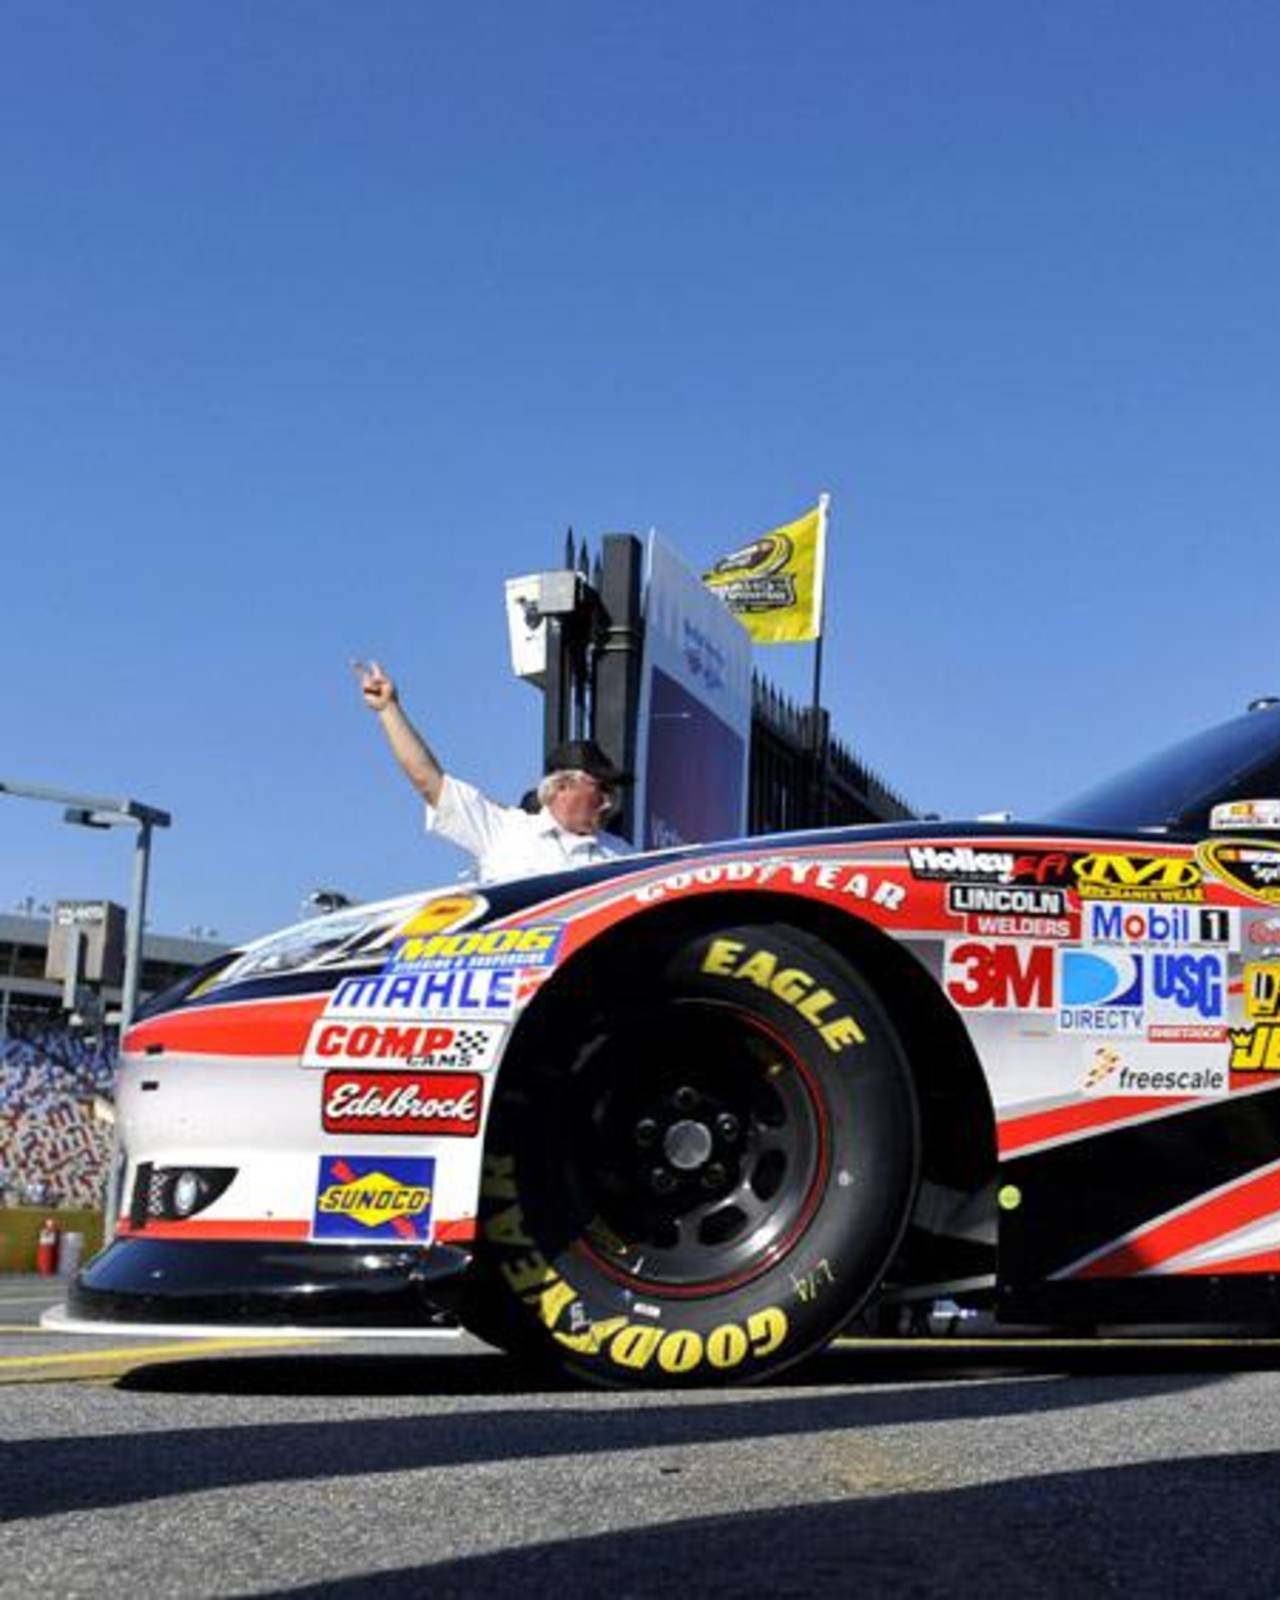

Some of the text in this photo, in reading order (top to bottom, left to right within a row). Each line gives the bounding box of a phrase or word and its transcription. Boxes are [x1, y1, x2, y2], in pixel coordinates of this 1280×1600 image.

[632, 855, 908, 911] GOODYEAR
[909, 847, 1015, 884] Holley
[953, 888, 1060, 915] LINCOLN
[976, 915, 1070, 938] WELDERS
[1092, 904, 1190, 942] Mobil
[402, 927, 556, 961] MOOG
[332, 969, 515, 1009] MAHLE
[948, 942, 1055, 1009] 3M
[1152, 953, 1223, 1018] USG
[701, 937, 866, 1053] EAGLE
[1059, 1009, 1144, 1030] DIRECTV
[315, 1024, 455, 1059] COMP
[405, 1053, 473, 1068] CAMS
[1118, 1065, 1225, 1090] freescale
[324, 1083, 477, 1121] Edelbrock
[323, 1189, 428, 1211] SUNOCO
